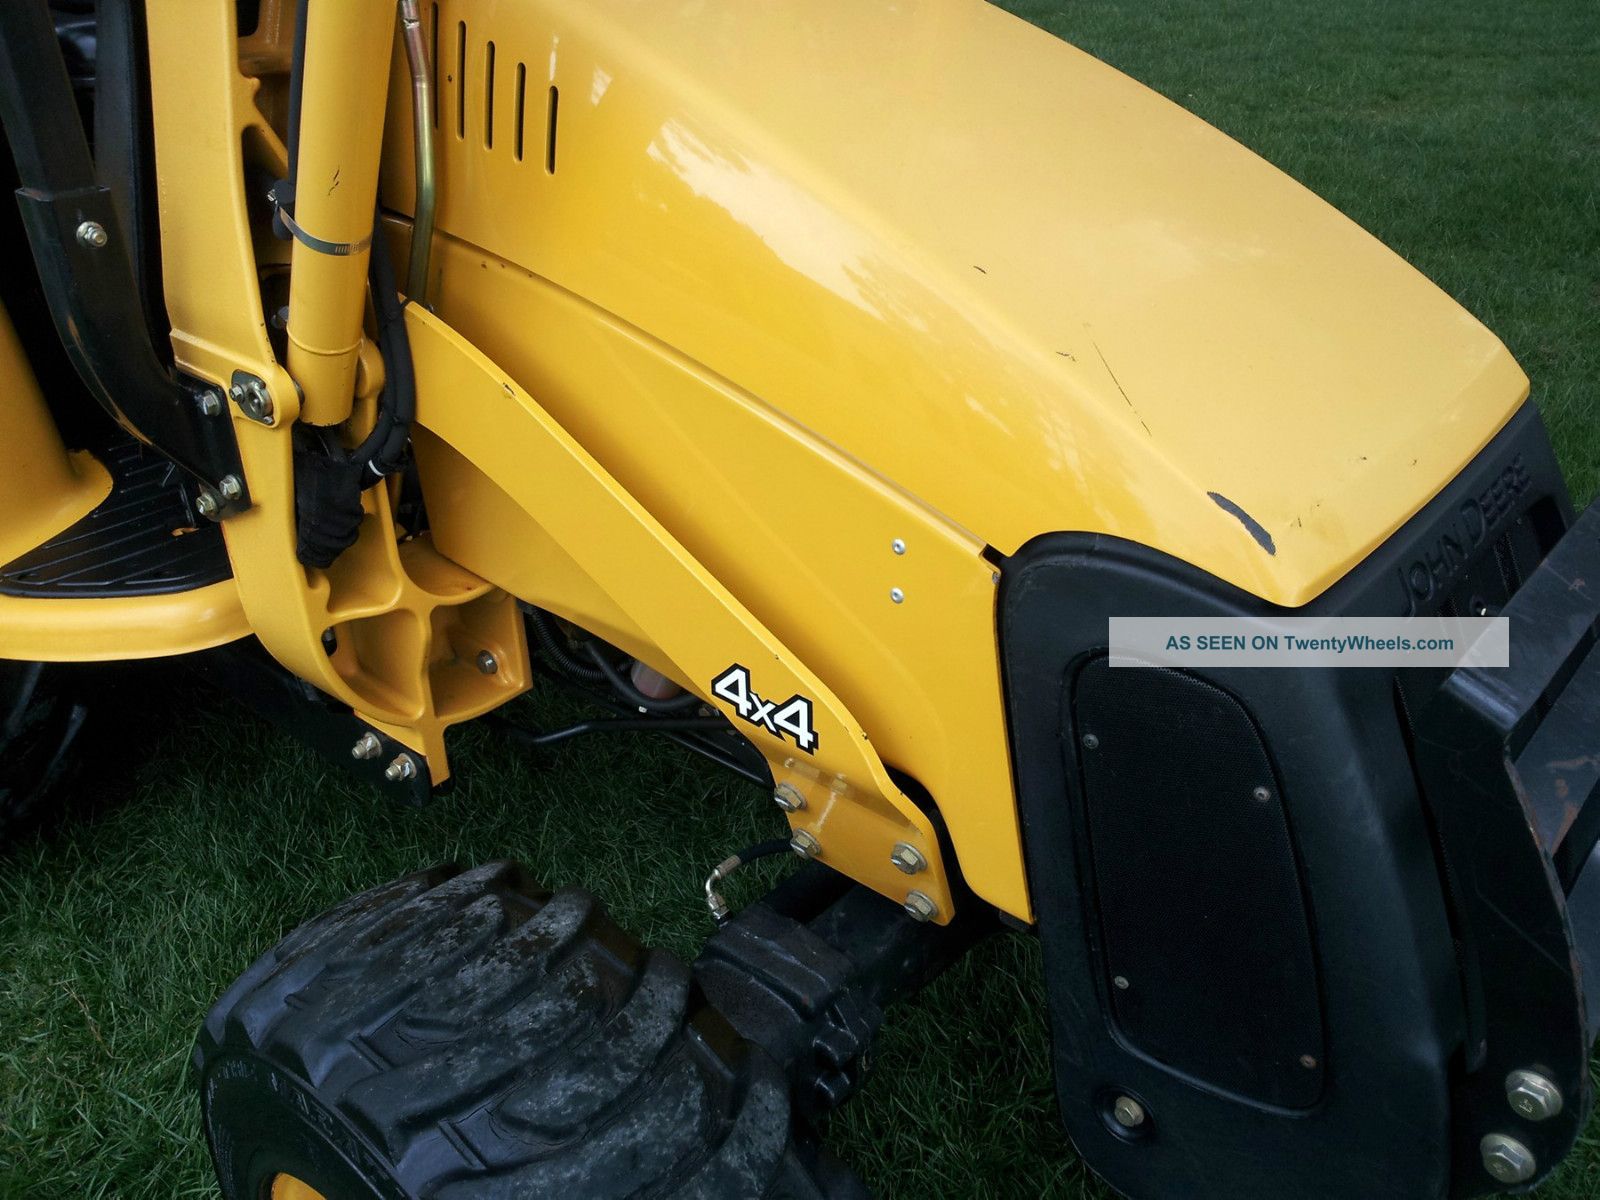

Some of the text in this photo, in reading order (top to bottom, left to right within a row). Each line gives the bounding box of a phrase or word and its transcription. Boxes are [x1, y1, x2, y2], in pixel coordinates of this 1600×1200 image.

[1397, 452, 1532, 622] JOHN DEERE
[712, 664, 818, 754] 4x4
